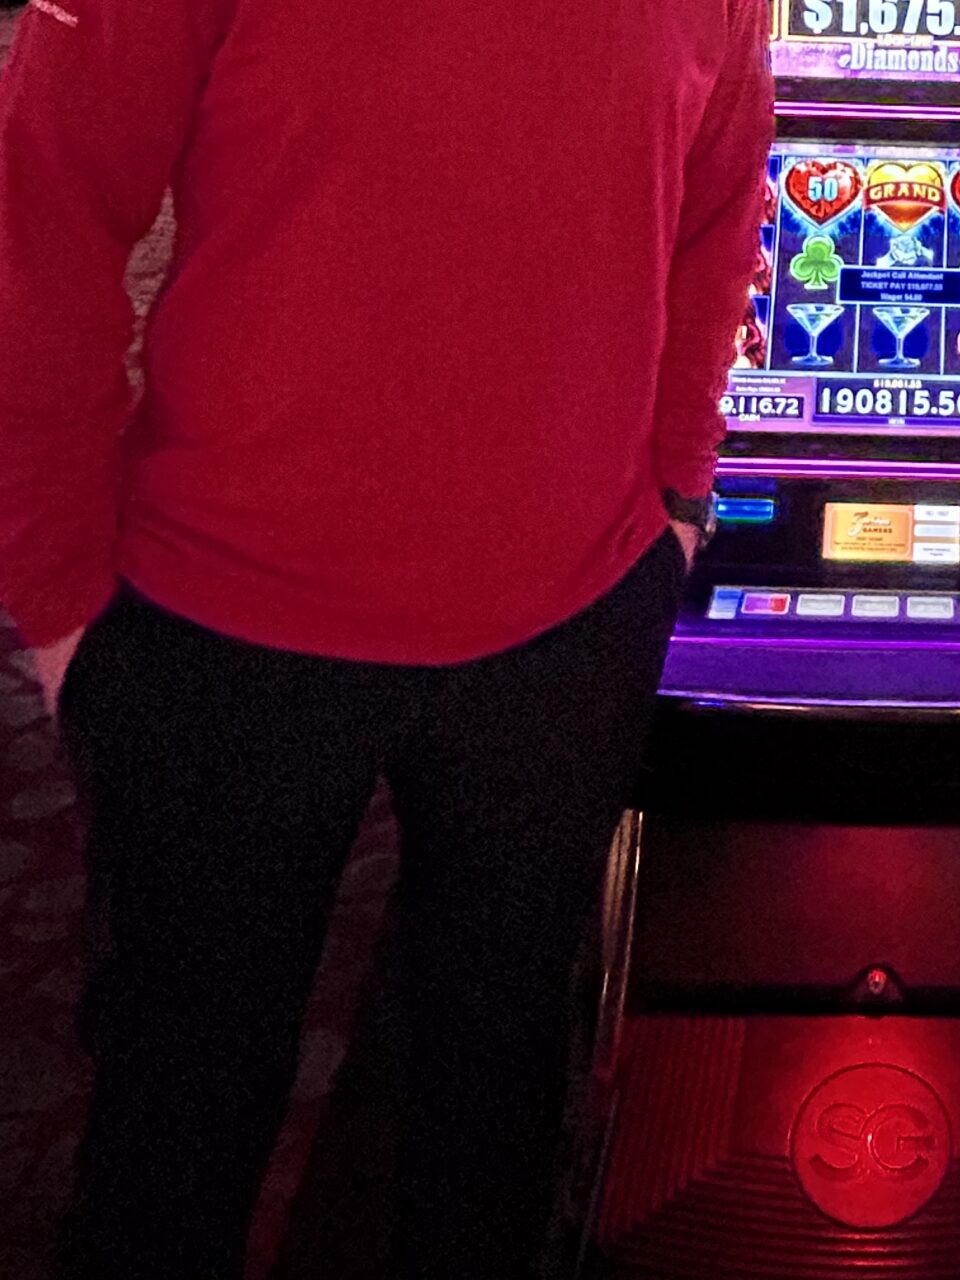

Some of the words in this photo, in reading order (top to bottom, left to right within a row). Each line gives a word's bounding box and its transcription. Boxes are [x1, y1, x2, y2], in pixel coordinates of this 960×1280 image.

[850, 42, 960, 73] Diamonds
[807, 175, 840, 202] 50
[868, 183, 941, 202] GRAND
[809, 1103, 935, 1182] SG
